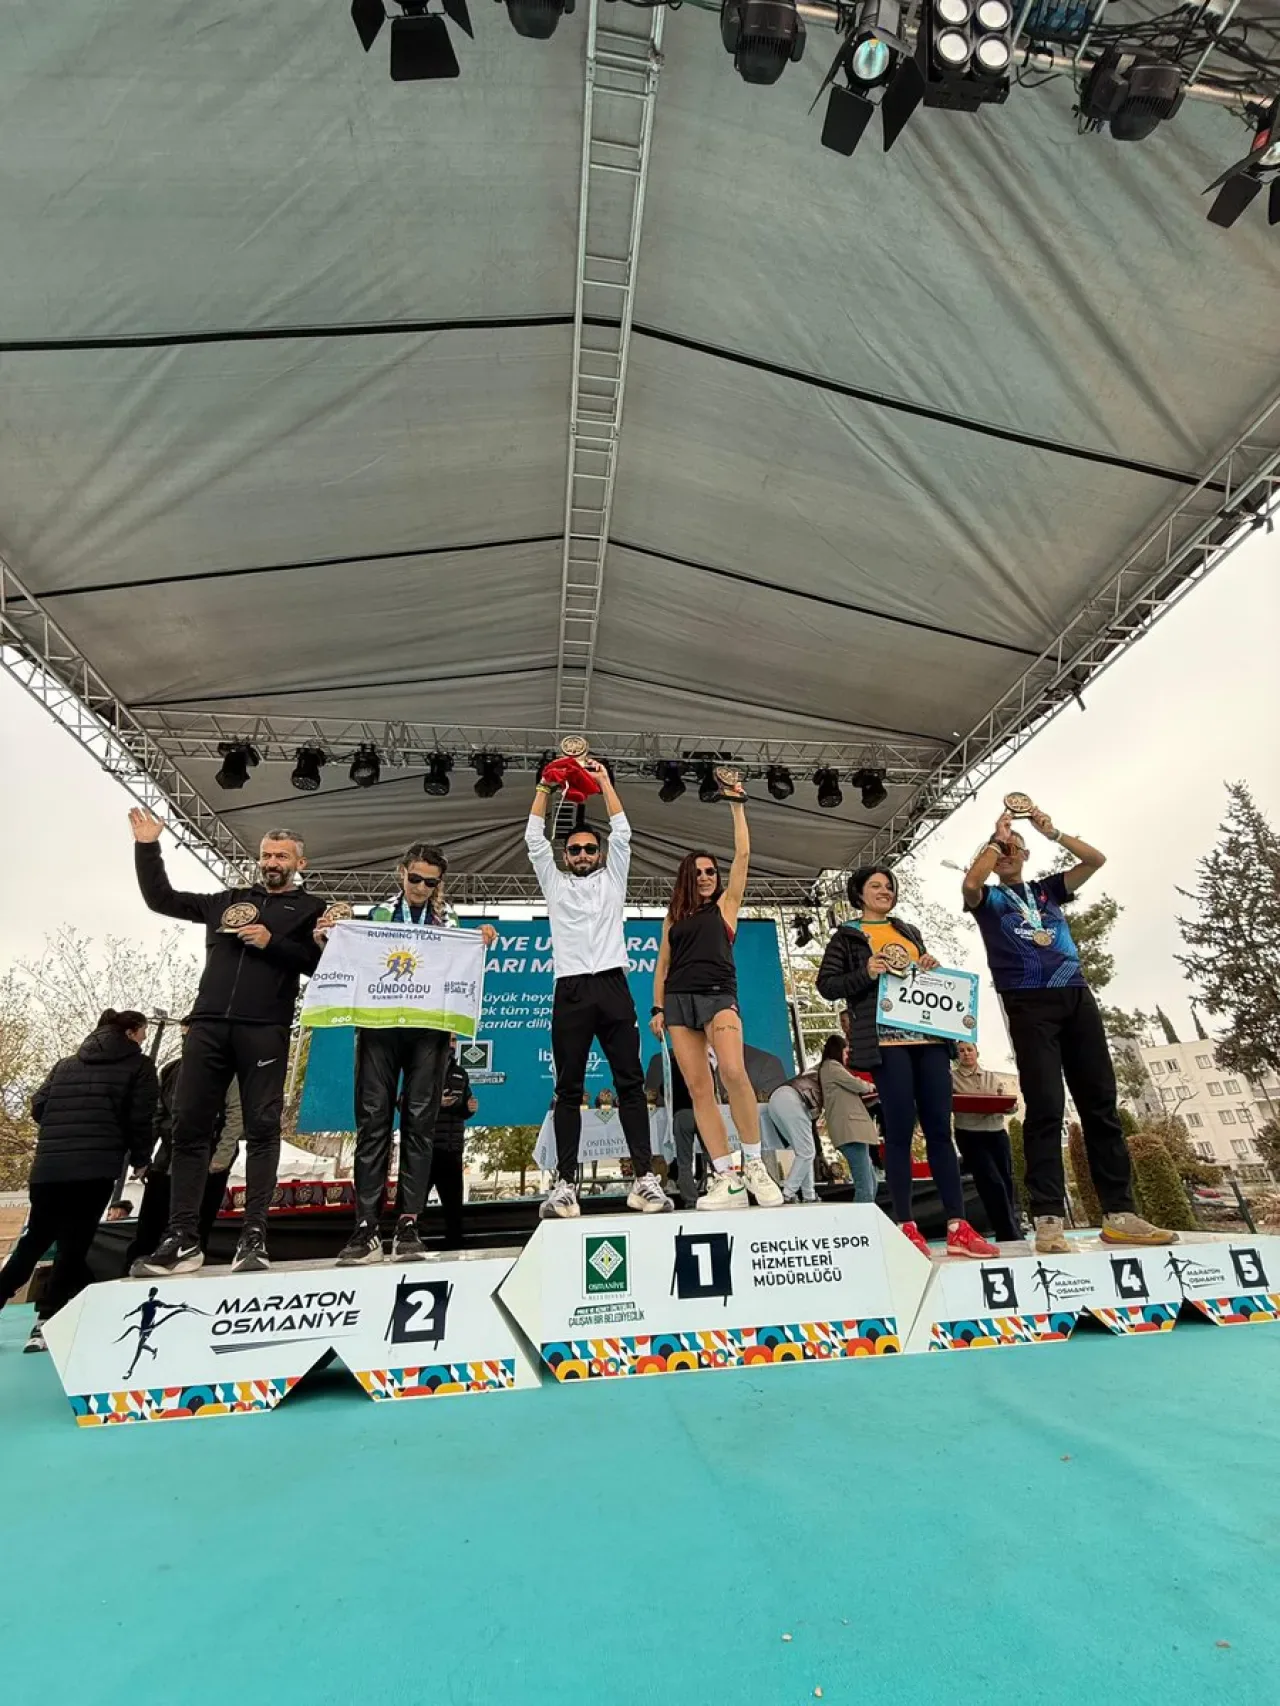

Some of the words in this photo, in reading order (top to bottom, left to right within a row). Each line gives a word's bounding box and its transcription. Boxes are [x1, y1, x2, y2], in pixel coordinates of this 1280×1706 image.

[368, 930, 412, 939] RUNNING
[489, 933, 530, 951] İYE
[534, 936, 553, 951] U
[626, 936, 659, 951] RA
[485, 957, 527, 973] ARI
[628, 958, 656, 973] ON
[483, 992, 517, 1004] üyük
[500, 1005, 530, 1015] tüm
[750, 1237, 809, 1255] GENÇLİK
[812, 1238, 830, 1250] VE
[833, 1236, 870, 1249] SPOR
[690, 1243, 714, 1287] 1
[751, 1251, 833, 1270] HİZMETLERİ
[1239, 1253, 1260, 1282] 5
[753, 1267, 843, 1288] MÜDÜRLÜĞÜ
[1120, 1263, 1143, 1291] 4
[988, 1273, 1010, 1303] 3
[215, 1290, 357, 1316] MARATON
[404, 1289, 436, 1333] 2
[211, 1308, 361, 1336] OSMANİYE
